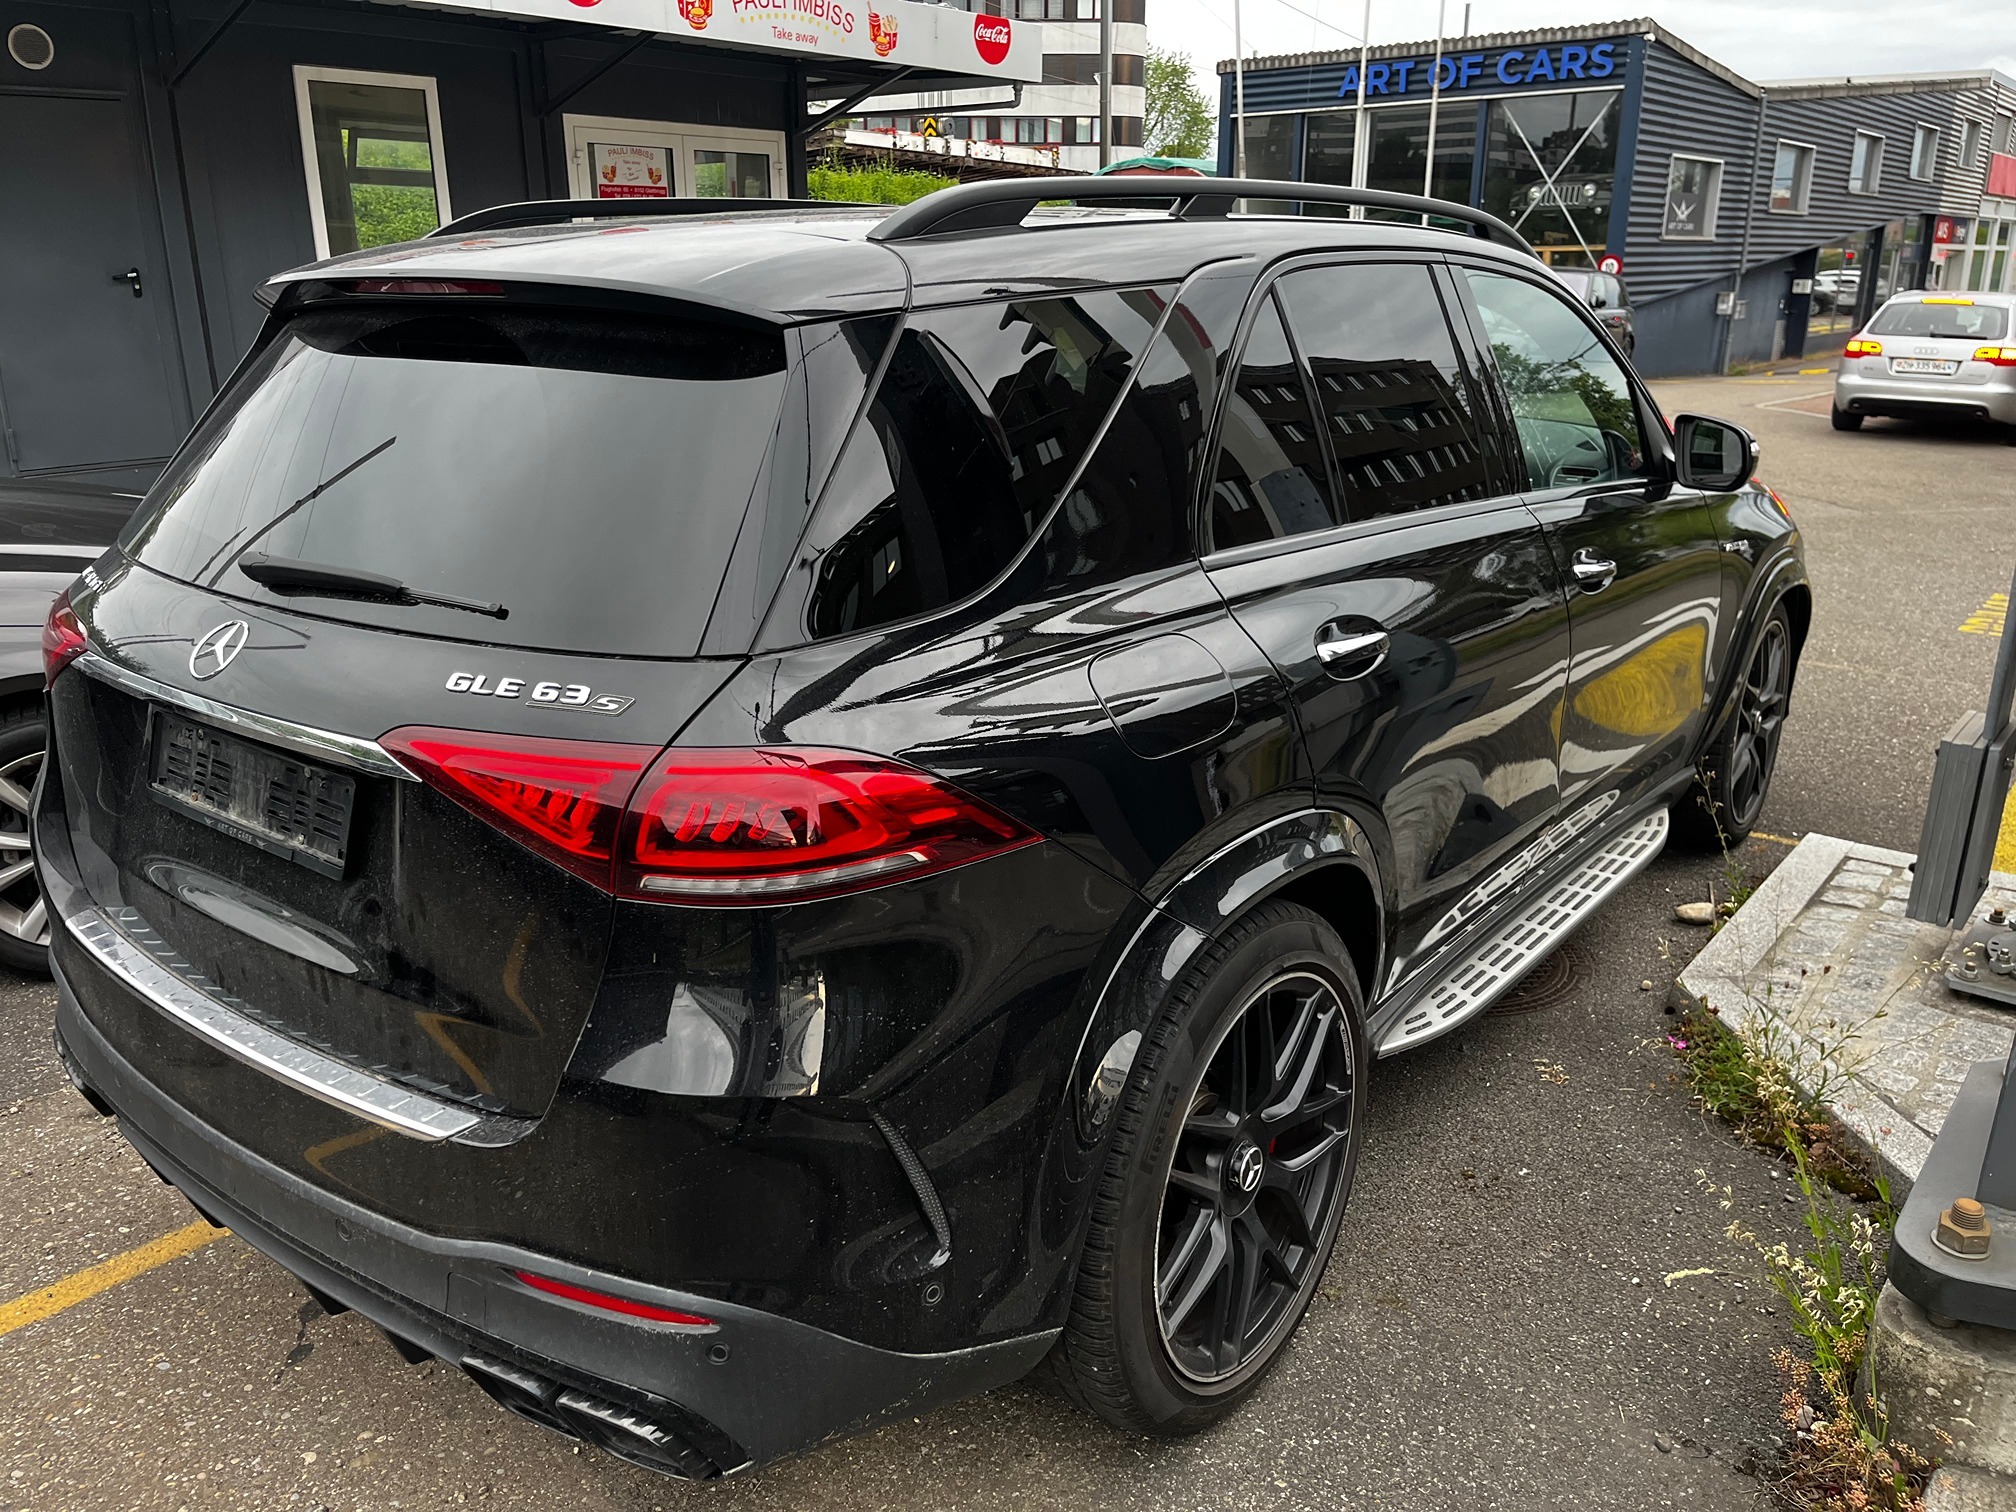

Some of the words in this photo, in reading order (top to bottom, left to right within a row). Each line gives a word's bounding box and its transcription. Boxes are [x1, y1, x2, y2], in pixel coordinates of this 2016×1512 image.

[793, 0, 855, 33] IMBISS
[771, 26, 793, 41] Take
[795, 32, 819, 47] away
[975, 24, 1009, 44] Coca-Cola
[1338, 61, 1415, 97] ART
[1426, 55, 1484, 90] OF
[1496, 43, 1615, 84] CARS
[607, 147, 628, 157] PAULI
[630, 147, 654, 160] IMBISS
[445, 672, 526, 698] GLE
[531, 681, 591, 706] 63
